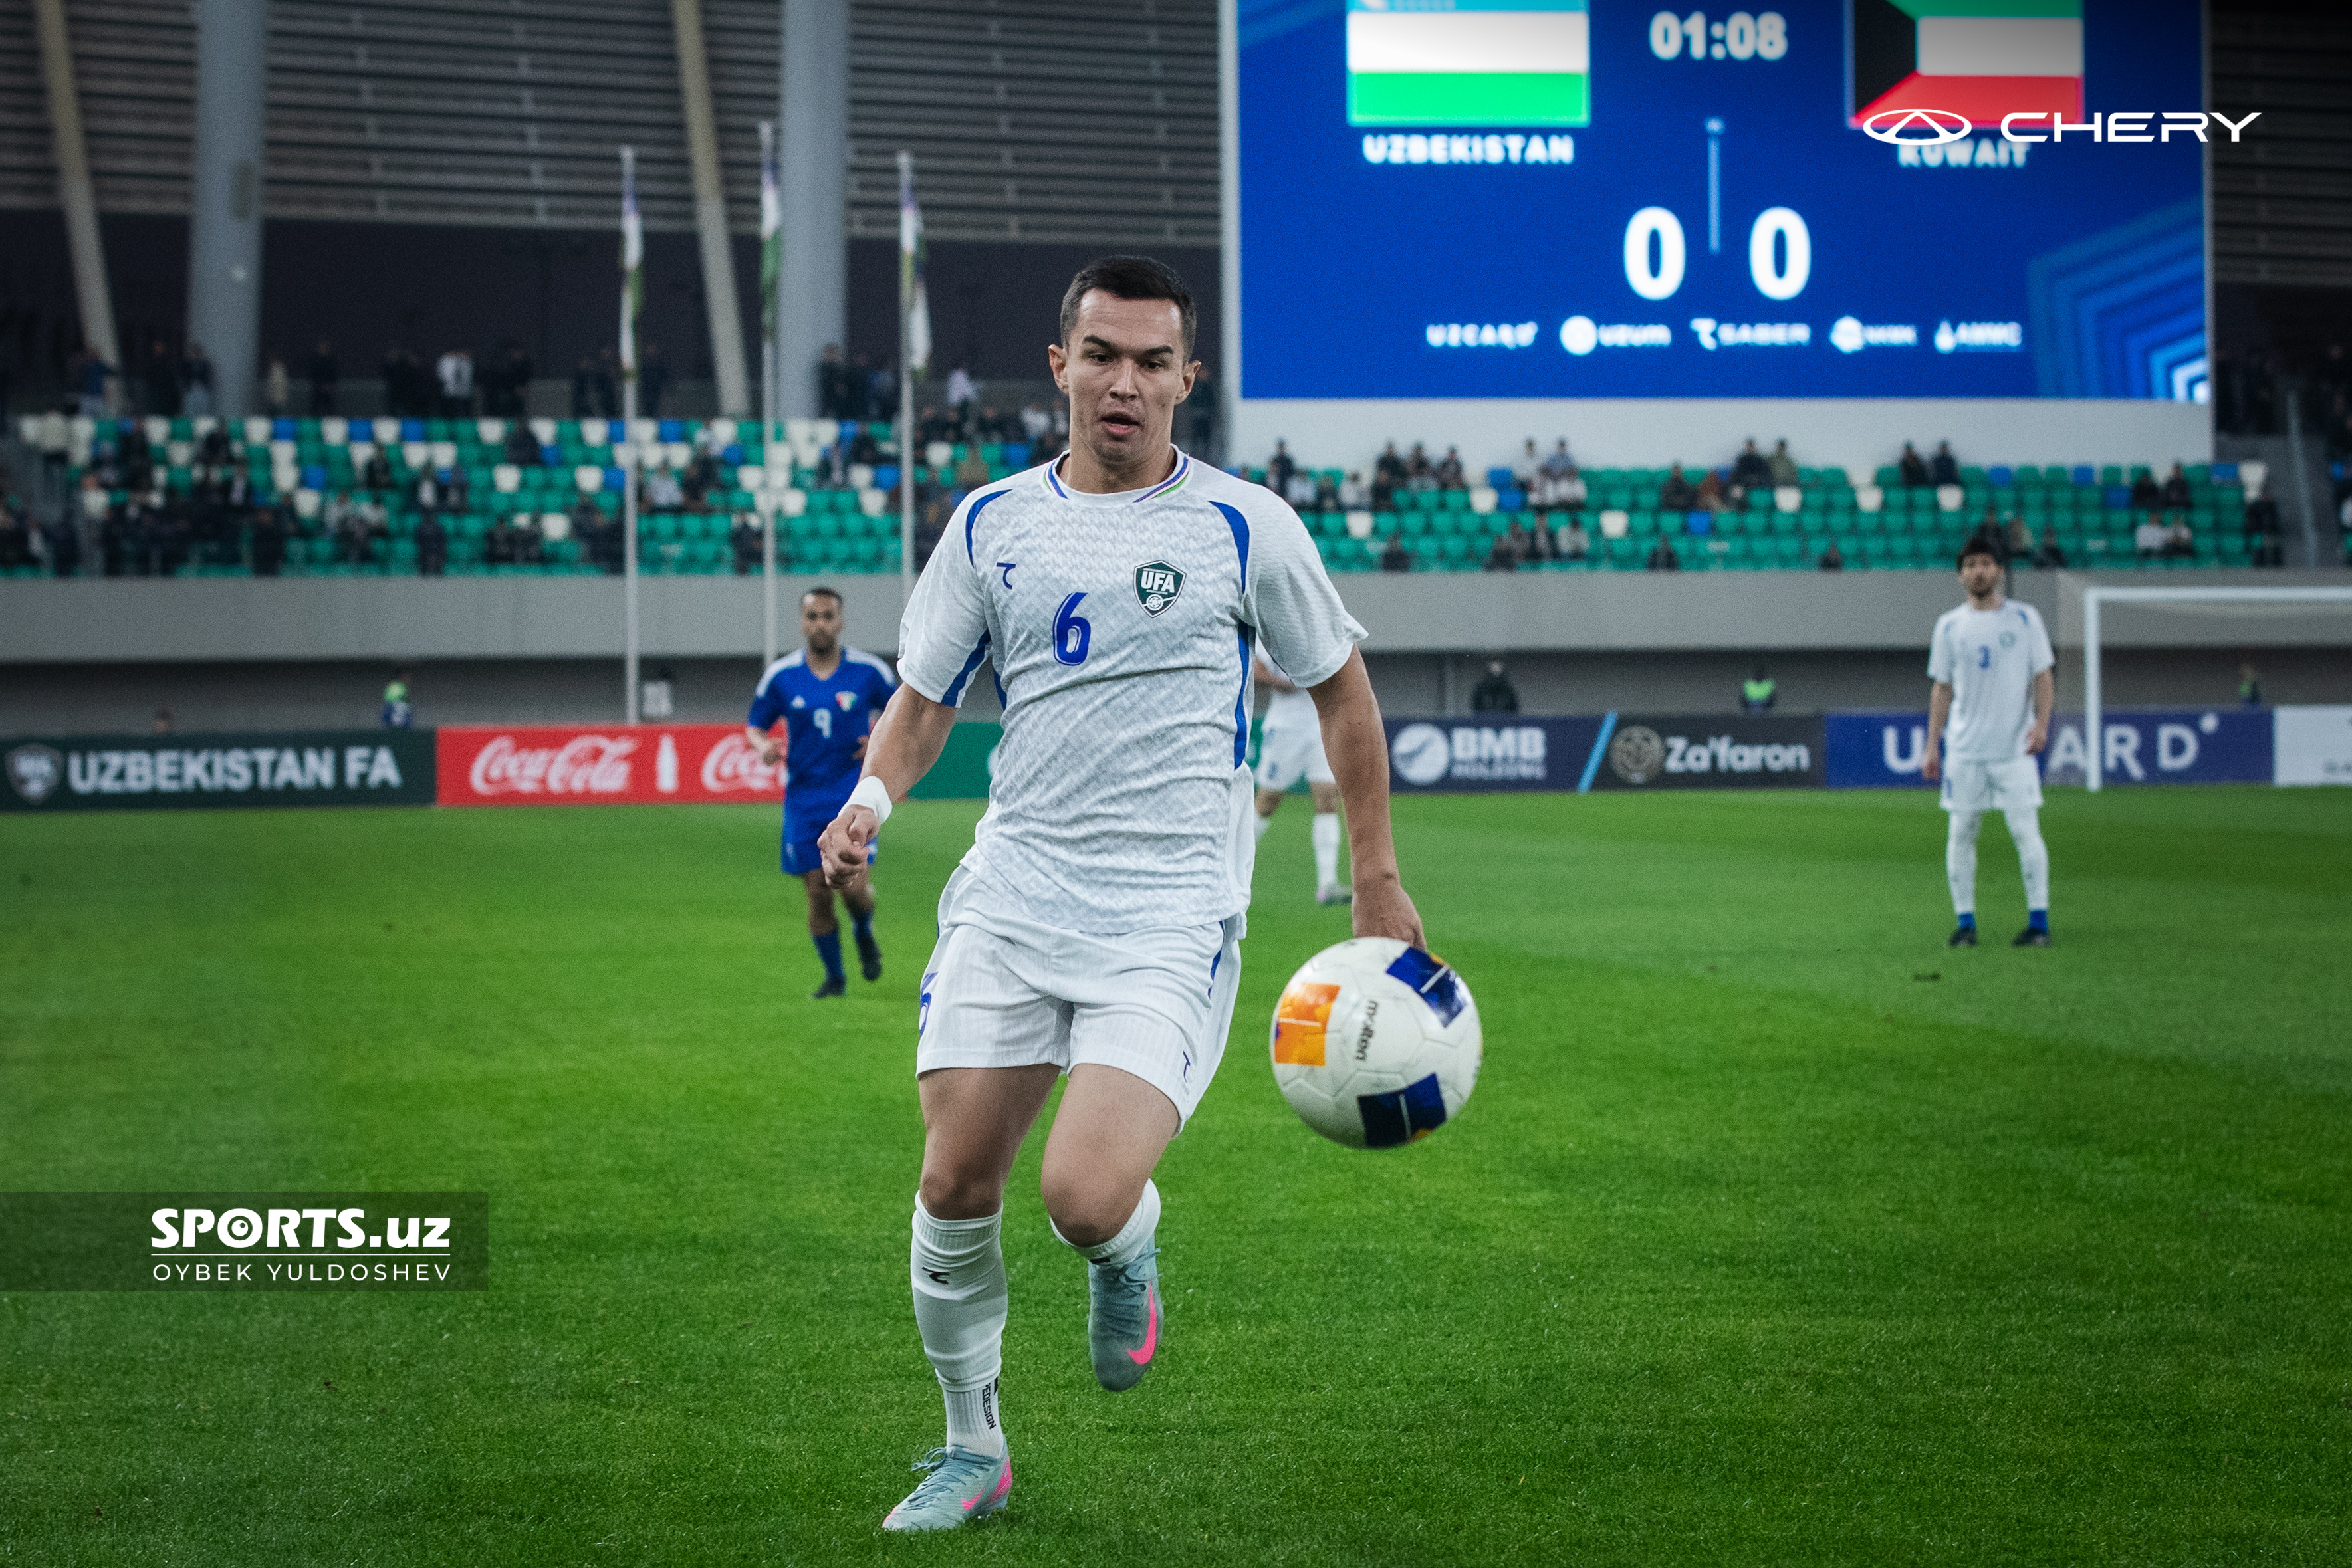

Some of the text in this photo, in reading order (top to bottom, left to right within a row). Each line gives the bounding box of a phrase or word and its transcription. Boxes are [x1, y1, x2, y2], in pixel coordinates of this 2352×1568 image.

[1649, 11, 1788, 61] 01:08
[1363, 134, 1574, 164] UZBEKISTAN
[1897, 138, 2032, 167] KUWAIT
[1623, 207, 1812, 300] 0 0
[1140, 570, 1175, 593] UFA
[1052, 592, 1092, 666] 6
[813, 707, 831, 739] 9
[1451, 727, 1547, 759] BMB
[68, 746, 333, 794] UZBEKISTAN
[344, 745, 402, 790] FA
[469, 735, 641, 795] Coca-Cola
